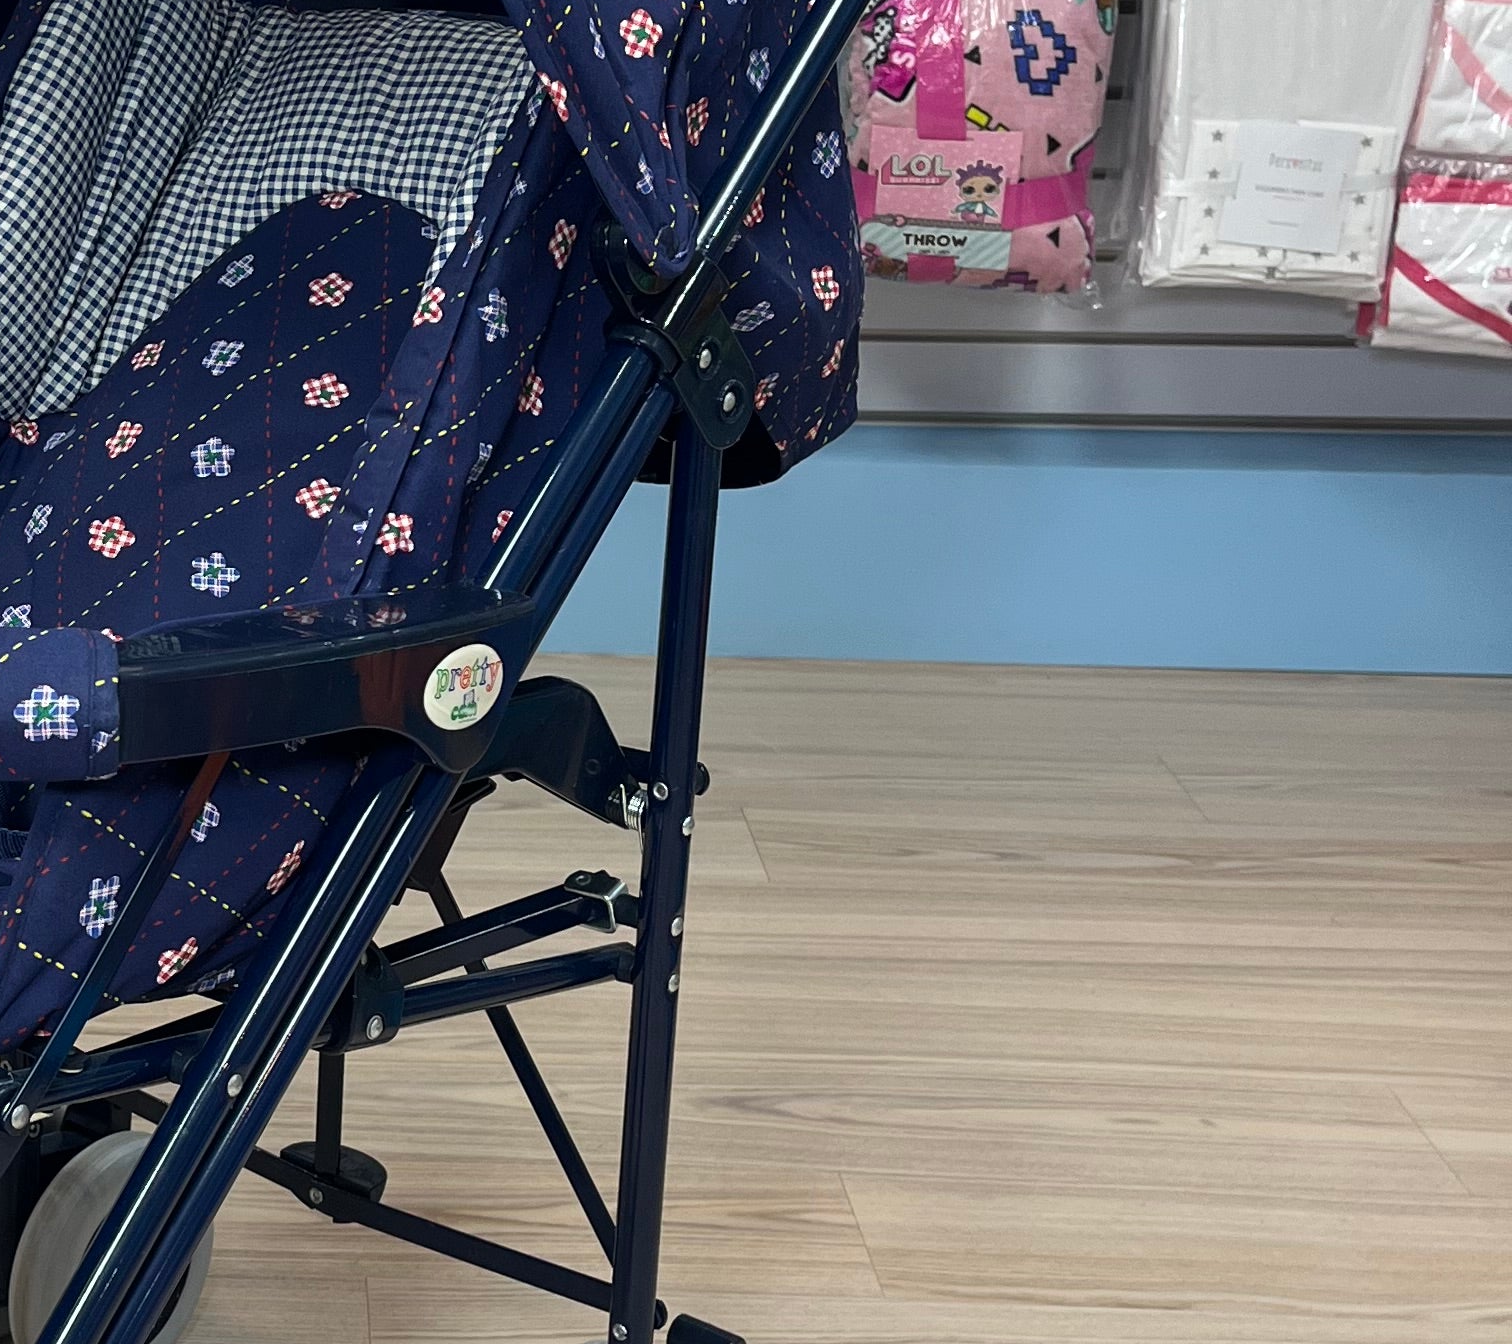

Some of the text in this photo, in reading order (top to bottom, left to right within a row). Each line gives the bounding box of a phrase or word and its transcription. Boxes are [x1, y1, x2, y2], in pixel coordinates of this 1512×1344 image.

[889, 154, 953, 178] LOL
[903, 232, 968, 248] THROW
[434, 656, 504, 700] pretty
